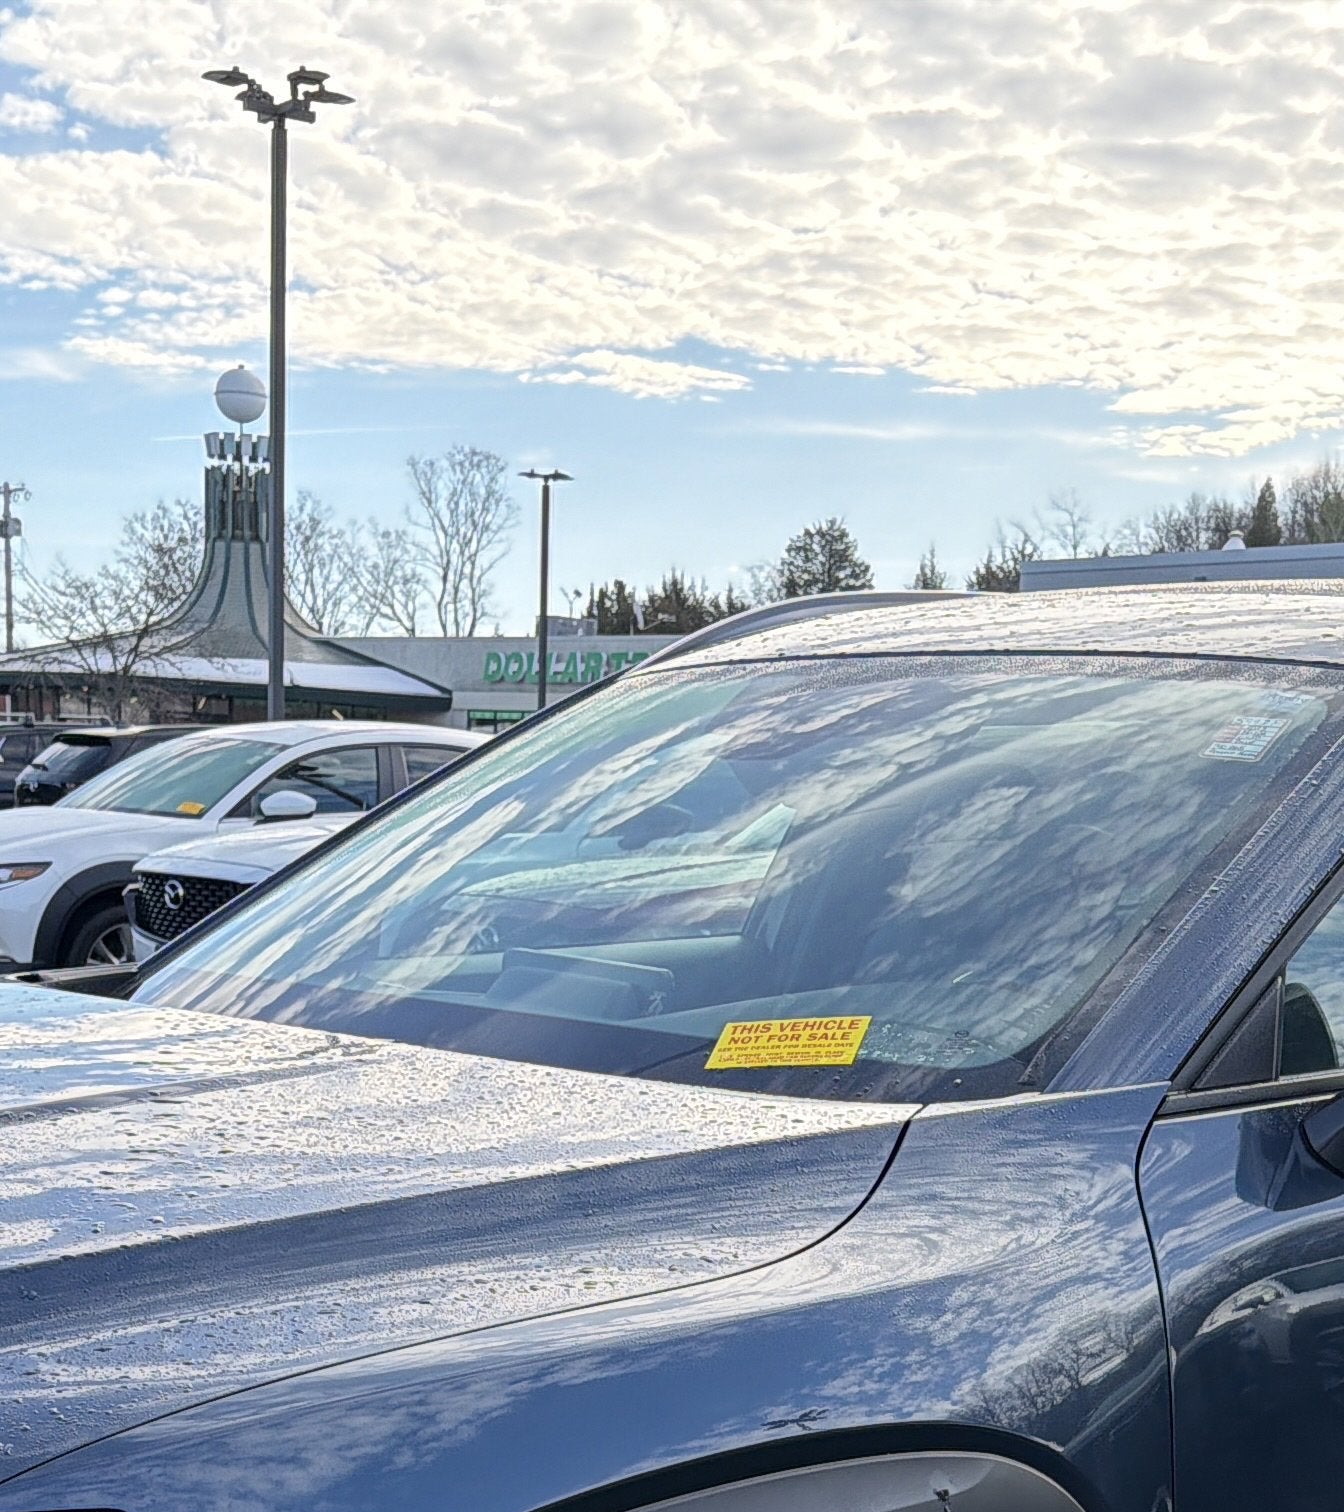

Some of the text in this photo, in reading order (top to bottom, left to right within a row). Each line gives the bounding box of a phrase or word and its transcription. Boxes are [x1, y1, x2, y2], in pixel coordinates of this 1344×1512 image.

[483, 651, 607, 684] DOLLAR
[731, 1018, 862, 1035] THIS VEHICLE
[728, 1031, 853, 1045] NOT FOR SALE
[750, 1043, 782, 1051] DEALER
